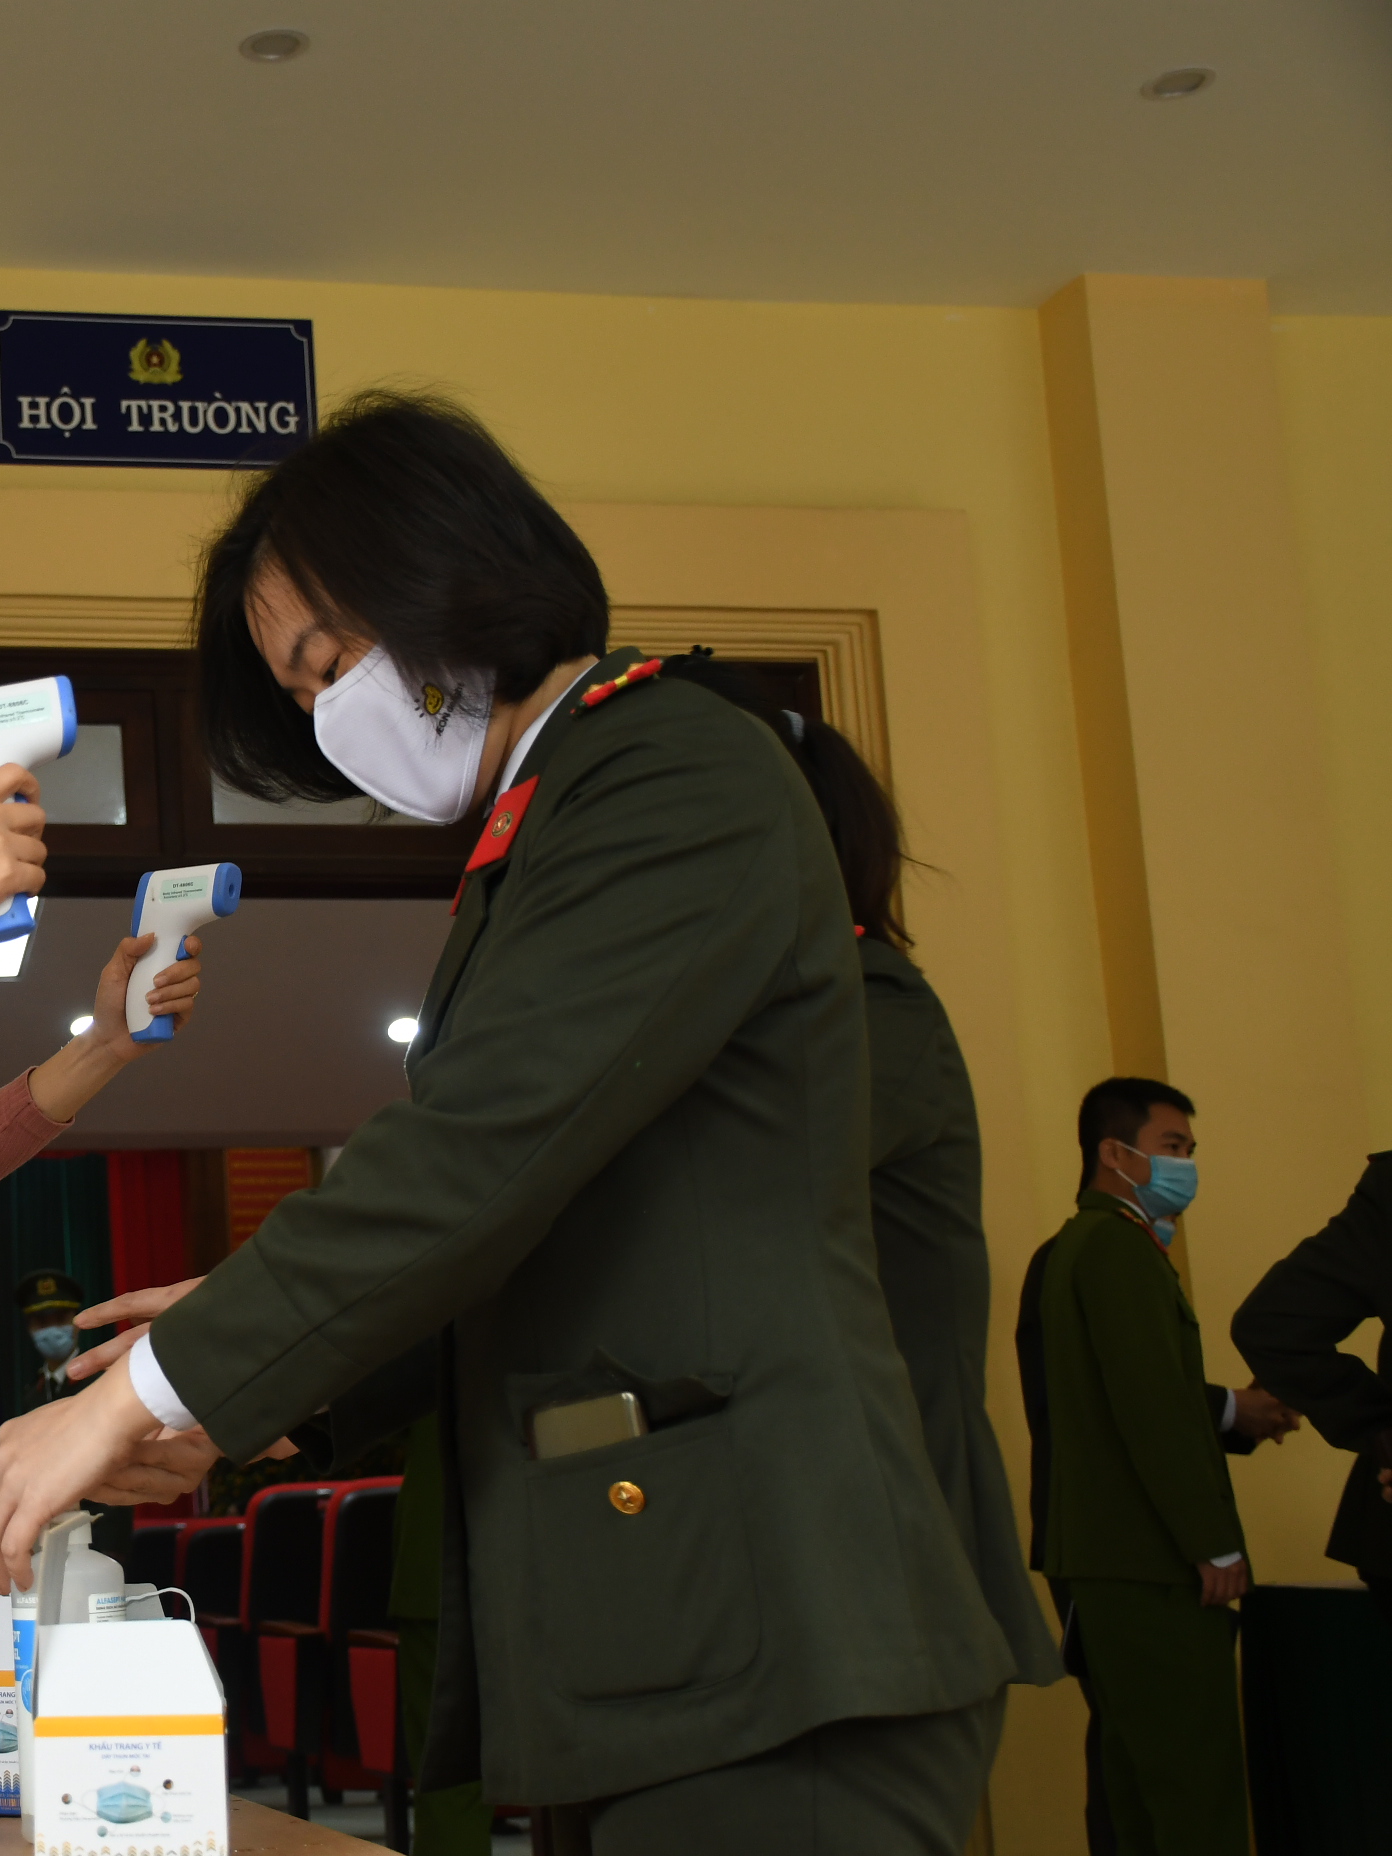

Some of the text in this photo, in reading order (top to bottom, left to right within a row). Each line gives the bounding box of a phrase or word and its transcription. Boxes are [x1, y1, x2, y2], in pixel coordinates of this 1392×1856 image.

[18, 386, 97, 438] HỘI
[115, 1742, 144, 1750] TRANG
[145, 1742, 151, 1750] Y
